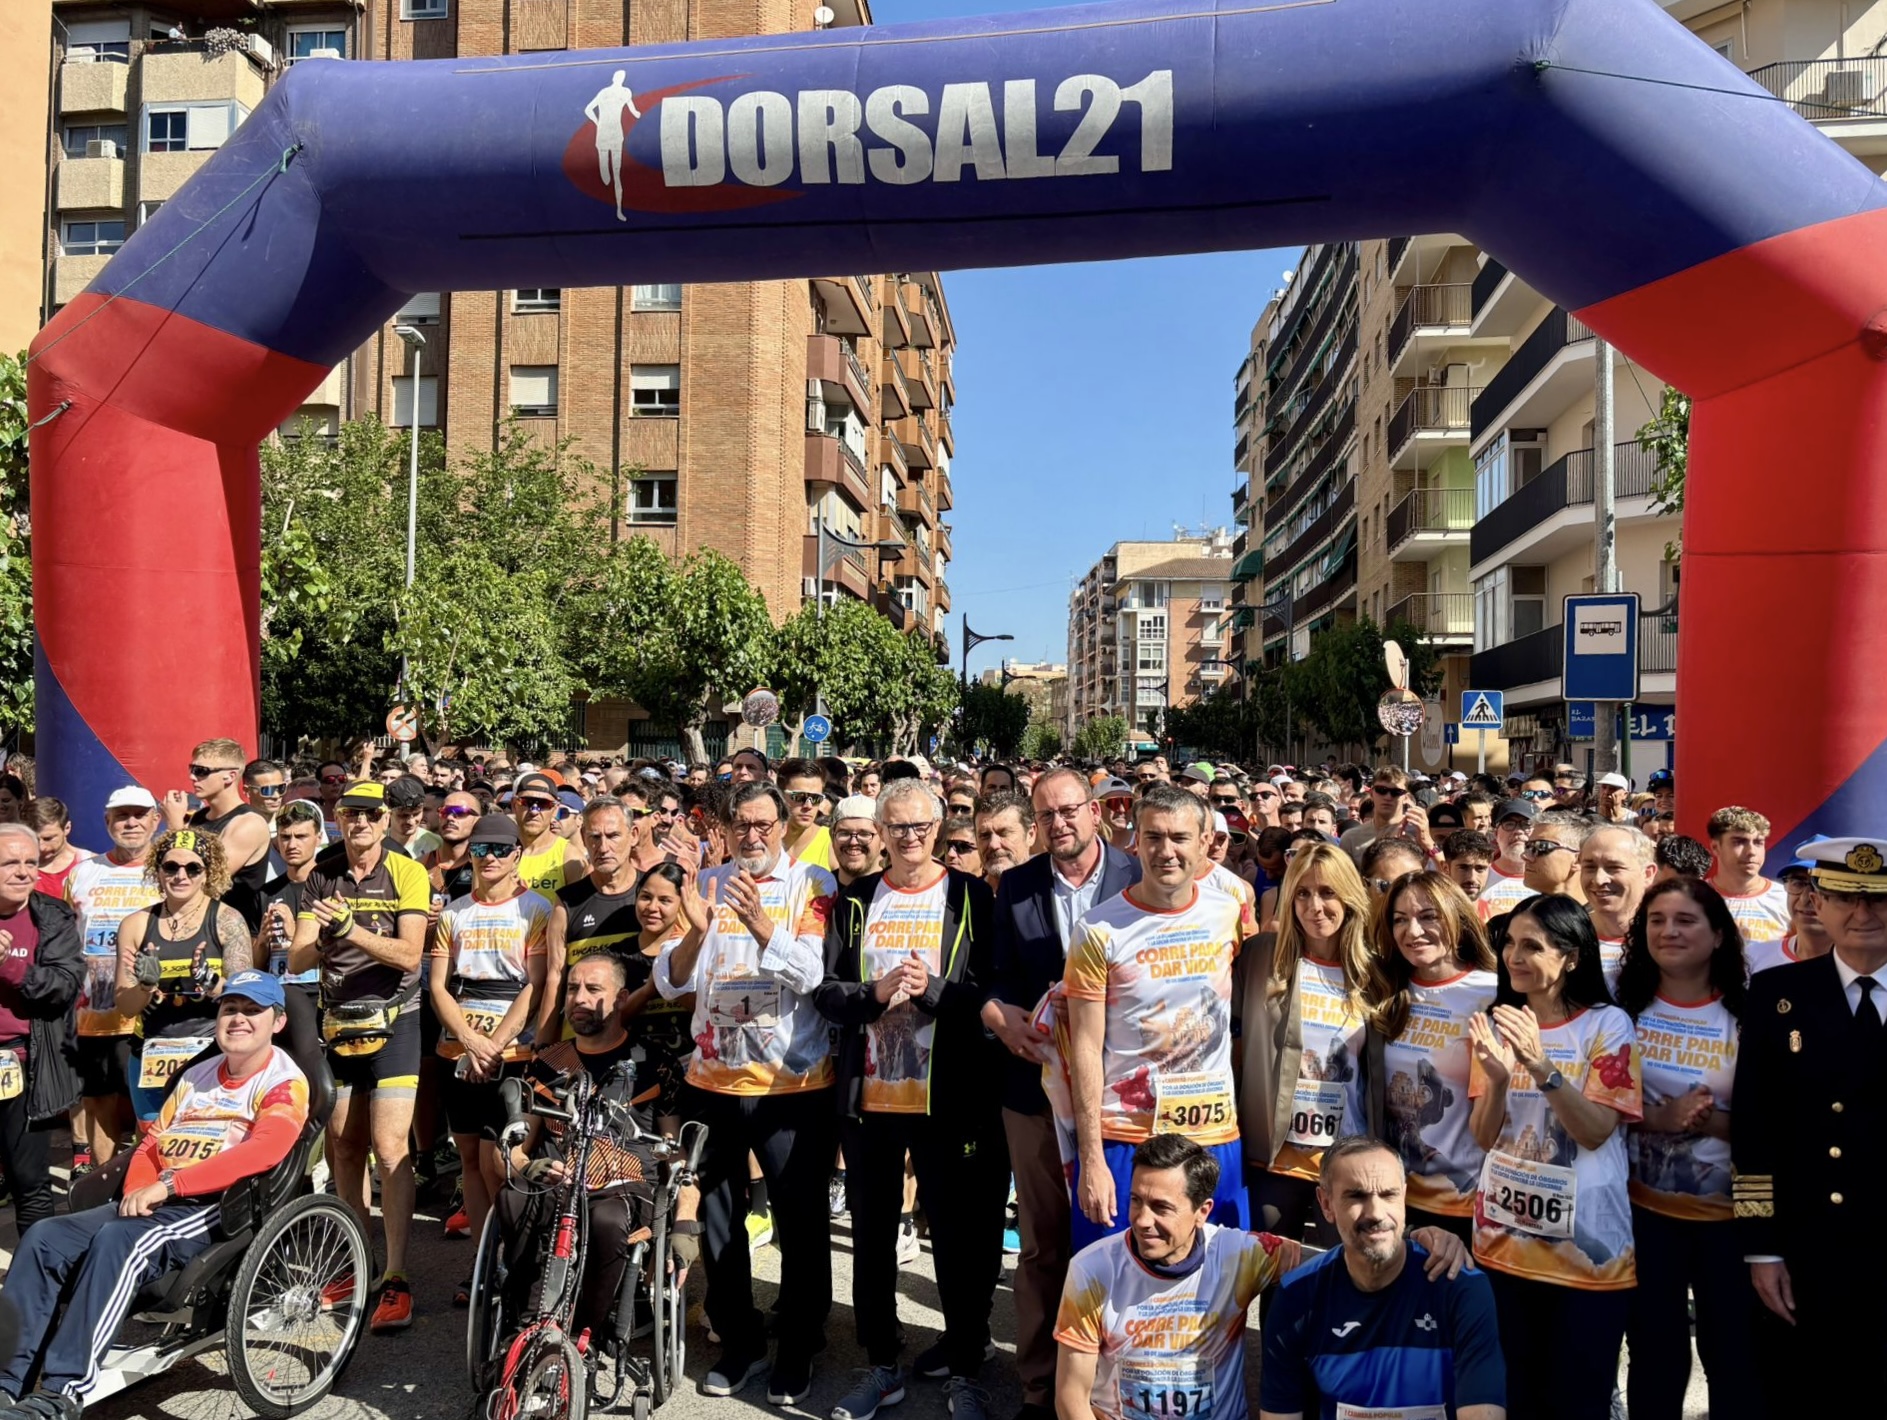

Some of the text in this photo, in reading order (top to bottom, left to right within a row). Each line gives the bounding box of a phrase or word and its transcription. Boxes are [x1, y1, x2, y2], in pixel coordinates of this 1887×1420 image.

[660, 69, 1174, 188] DORSAL21
[88, 886, 127, 897] CORRE
[93, 896, 119, 908] DAR
[459, 929, 493, 940] CORRE
[868, 921, 942, 934] CORRE PAR
[464, 939, 486, 951] DAR
[875, 934, 939, 948] DAR VIDA
[9, 948, 28, 958] AD
[1136, 945, 1187, 965] CORRE
[1151, 957, 1217, 979] DAR VIDA
[741, 995, 750, 1015] 1
[1301, 992, 1327, 1009] RRE
[1301, 1006, 1318, 1020] AR
[1422, 1018, 1461, 1036] PARA
[1410, 1031, 1445, 1048] VIDA
[1636, 1027, 1735, 1057] ORRE PARA
[1676, 1051, 1721, 1071] VIDA
[1, 1071, 13, 1088] 4
[1510, 1074, 1532, 1090] AR
[1173, 1102, 1225, 1126] 3075
[1292, 1111, 1336, 1136] 066
[164, 1138, 214, 1160] 2015
[1500, 1186, 1562, 1223] 2506
[1139, 1389, 1203, 1417] 1197
